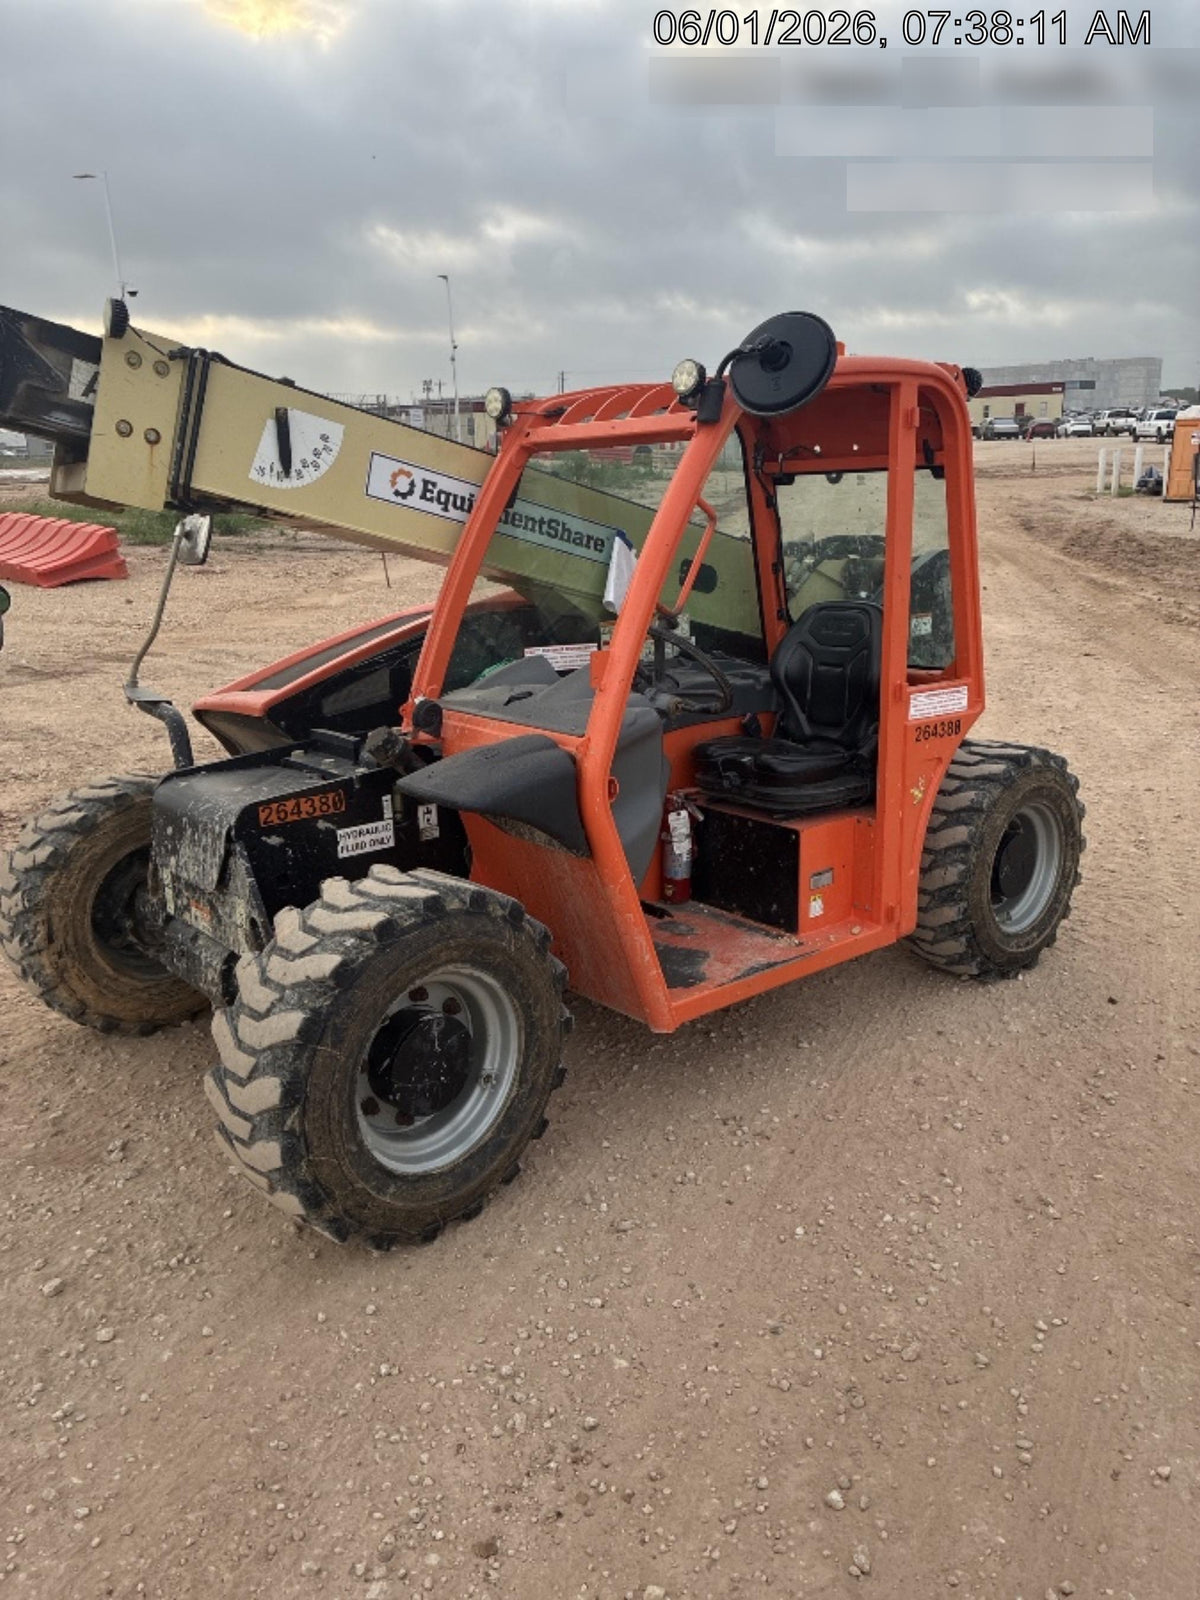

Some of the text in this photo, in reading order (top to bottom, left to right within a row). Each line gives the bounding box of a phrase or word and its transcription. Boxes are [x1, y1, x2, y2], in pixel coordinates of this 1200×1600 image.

[418, 478, 606, 553] EquientShare
[261, 793, 344, 825] 264380
[339, 823, 392, 840] HYDRAULIC
[340, 835, 391, 854] FLUID ONLY
